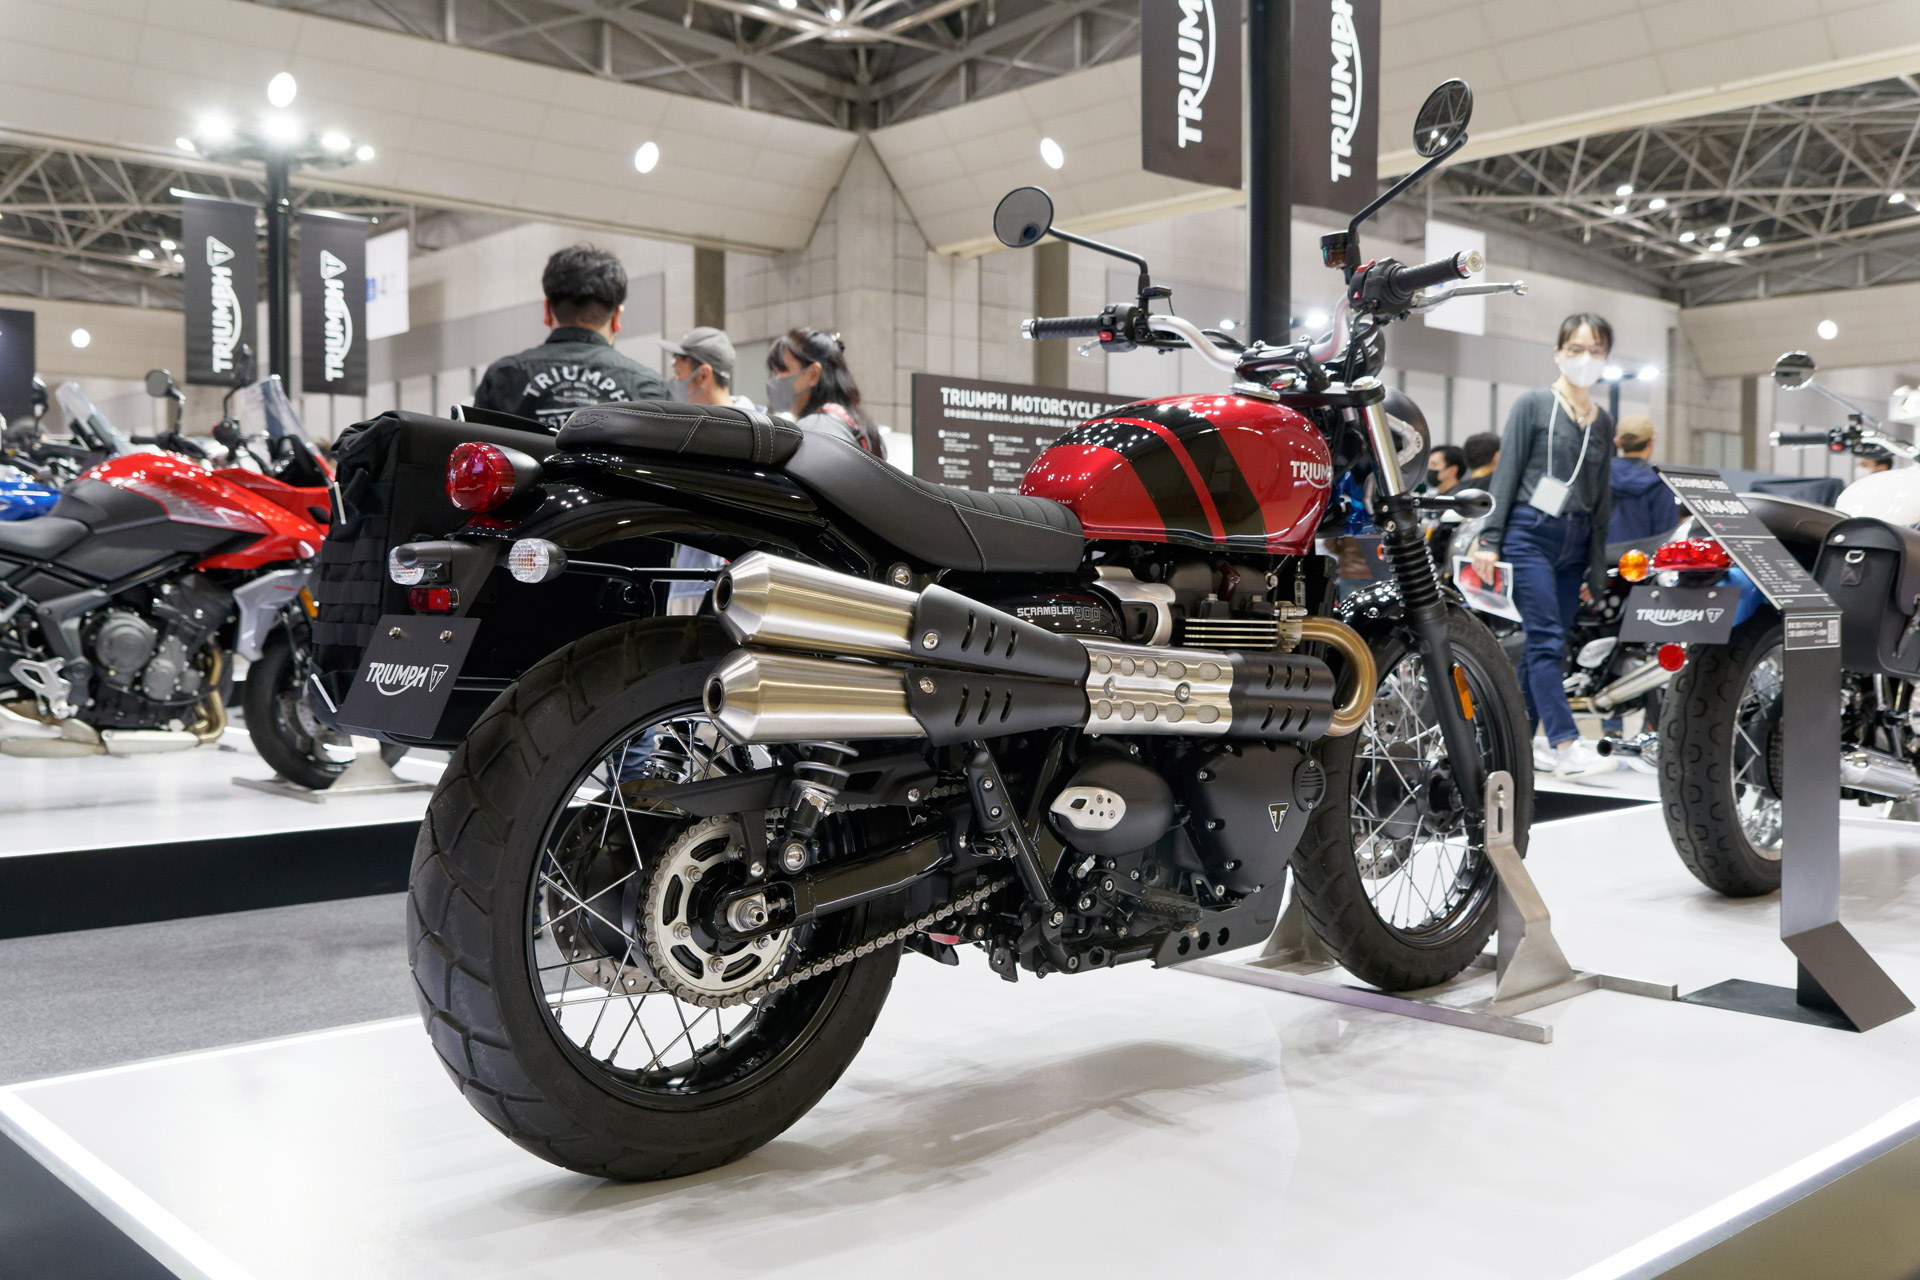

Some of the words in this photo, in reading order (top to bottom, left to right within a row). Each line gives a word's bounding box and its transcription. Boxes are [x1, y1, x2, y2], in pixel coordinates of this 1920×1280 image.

[1178, 0, 1216, 148] TRIUM
[211, 266, 242, 373] TRIUMPH
[324, 279, 353, 382] TRIUMPH
[940, 387, 1007, 410] TRIUMPH
[1011, 395, 1101, 418] MOTORCYCLE
[1290, 460, 1333, 489] TRIUM
[1016, 605, 1074, 617] SCRAMBLER
[1074, 606, 1100, 620] 900
[1636, 608, 1704, 627] TRIUMPH
[365, 662, 430, 696] TRIUMPH
